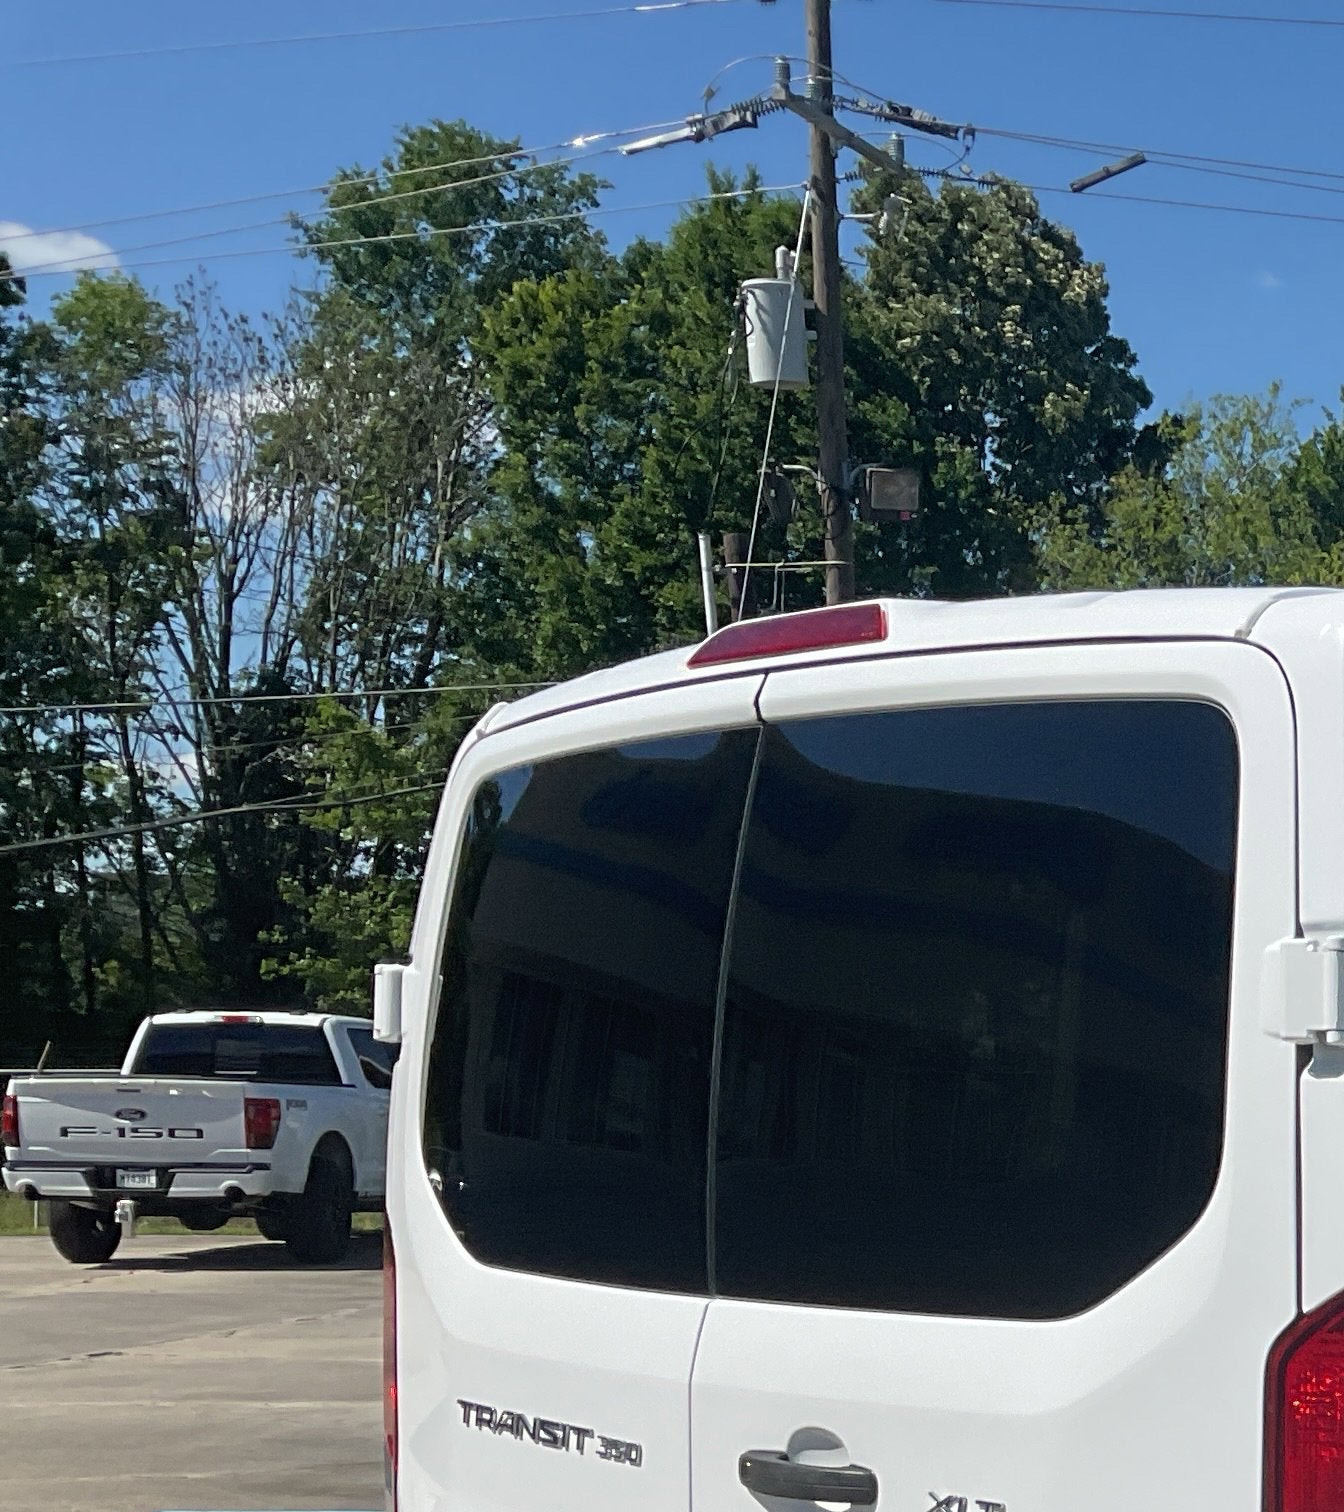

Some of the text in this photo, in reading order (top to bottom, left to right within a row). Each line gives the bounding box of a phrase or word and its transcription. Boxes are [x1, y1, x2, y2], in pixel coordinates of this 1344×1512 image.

[60, 1126, 204, 1139] F-150
[456, 1399, 643, 1468] TRANSIT 350
